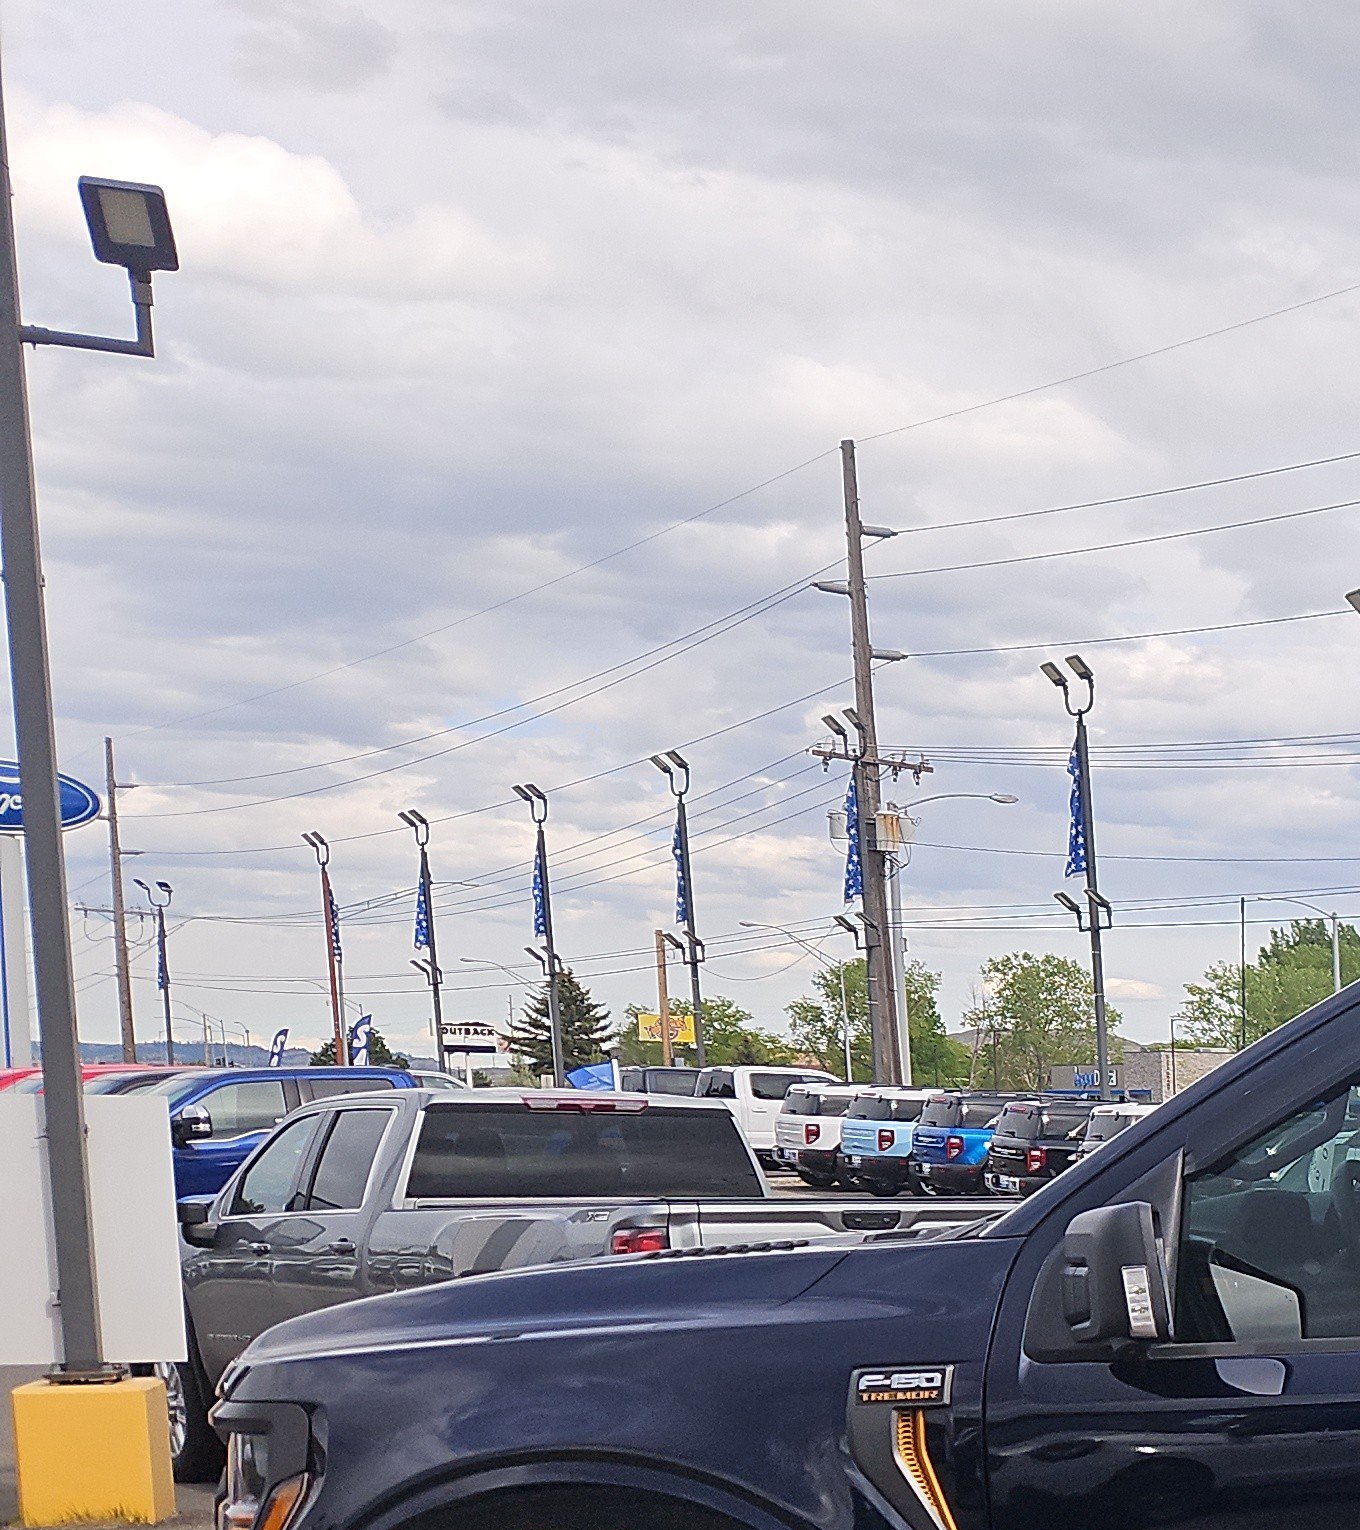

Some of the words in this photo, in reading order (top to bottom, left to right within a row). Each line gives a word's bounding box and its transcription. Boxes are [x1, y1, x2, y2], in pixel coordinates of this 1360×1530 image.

[440, 1027, 495, 1037] OUTBACK
[858, 1372, 943, 1391] F-150
[858, 1390, 941, 1402] TREMOR
